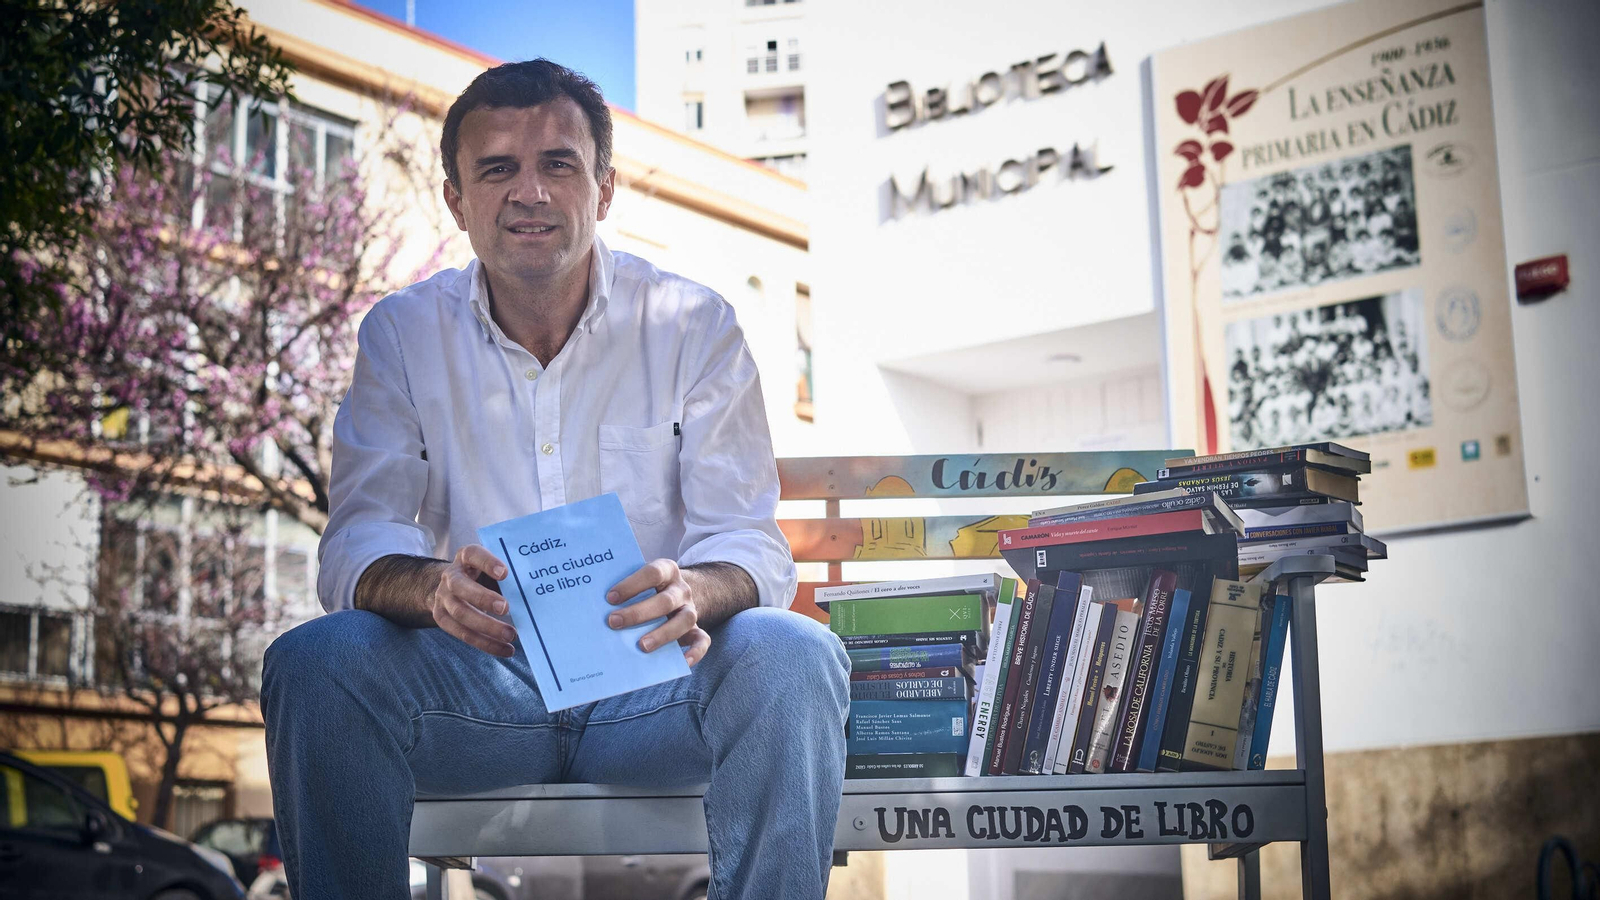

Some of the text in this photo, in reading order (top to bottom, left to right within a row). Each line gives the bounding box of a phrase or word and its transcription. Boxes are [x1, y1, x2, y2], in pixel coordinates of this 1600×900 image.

[884, 41, 1114, 132] BIBLIOTECA
[1326, 62, 1456, 112] ENSEÑANZA
[1242, 128, 1341, 169] PRIMARIA
[1348, 121, 1376, 145] EN
[882, 142, 1114, 219] MUNICIPAL
[1193, 454, 1222, 463] VENDRÁN
[1223, 452, 1249, 460] TIEMPOS
[1250, 448, 1274, 456] PEORES
[931, 458, 1063, 491] Cádiz
[1191, 462, 1223, 471] MUERTE
[1178, 474, 1231, 487] JESÚS CAÑADAS
[1206, 482, 1228, 491] FERMÍN
[1220, 488, 1232, 496] LAS
[1161, 495, 1206, 510] Cádiz oculto
[1020, 532, 1049, 540] CAMARÓN
[1249, 528, 1292, 539] CONVERSACIONES
[518, 537, 567, 556] Cádiz,
[528, 549, 615, 580] una ciudad
[535, 574, 592, 596] de libro
[823, 588, 846, 598] Fernando
[847, 587, 870, 597] Quiñones
[1142, 587, 1160, 636] JESÚS MAESO
[1151, 590, 1168, 636] DE LA TORRE
[1170, 627, 1178, 642] Vallejo
[1216, 628, 1225, 648] CADIZ
[1109, 624, 1129, 679] ASEDIO
[1214, 655, 1220, 665] SU
[1042, 634, 1061, 695] LIBERTY UNDER SIEGE
[1086, 690, 1095, 706] Manuel
[1095, 640, 1106, 666] Mataperros
[1133, 642, 1153, 696] CALIFORNIA
[1225, 651, 1235, 682] HISTORIA
[1266, 665, 1277, 680] CÁDIZ
[569, 675, 586, 683] Bruno
[895, 679, 929, 689] CARLOS
[930, 679, 942, 687] DE
[993, 591, 1035, 767] Manuel Bustos Rodríguez BREVE HISTORIA DE CÁDIZ
[1180, 677, 1188, 693] Benito
[1207, 665, 1219, 701] PROVINCIA
[878, 690, 890, 698] EL
[895, 688, 942, 698] ABELARDO
[994, 683, 1003, 703] OLIVIA
[1020, 689, 1030, 710] Nogales
[1058, 690, 1067, 713] ANDALUZ
[1130, 696, 1141, 709] DE
[1264, 686, 1274, 702] HABLA
[974, 701, 991, 738] ENERGY
[1016, 710, 1025, 728] Chaves
[1125, 709, 1138, 734] ROSA
[1122, 734, 1132, 746] LA
[874, 799, 1255, 844] UNA CIUDAD DE LIBRO
